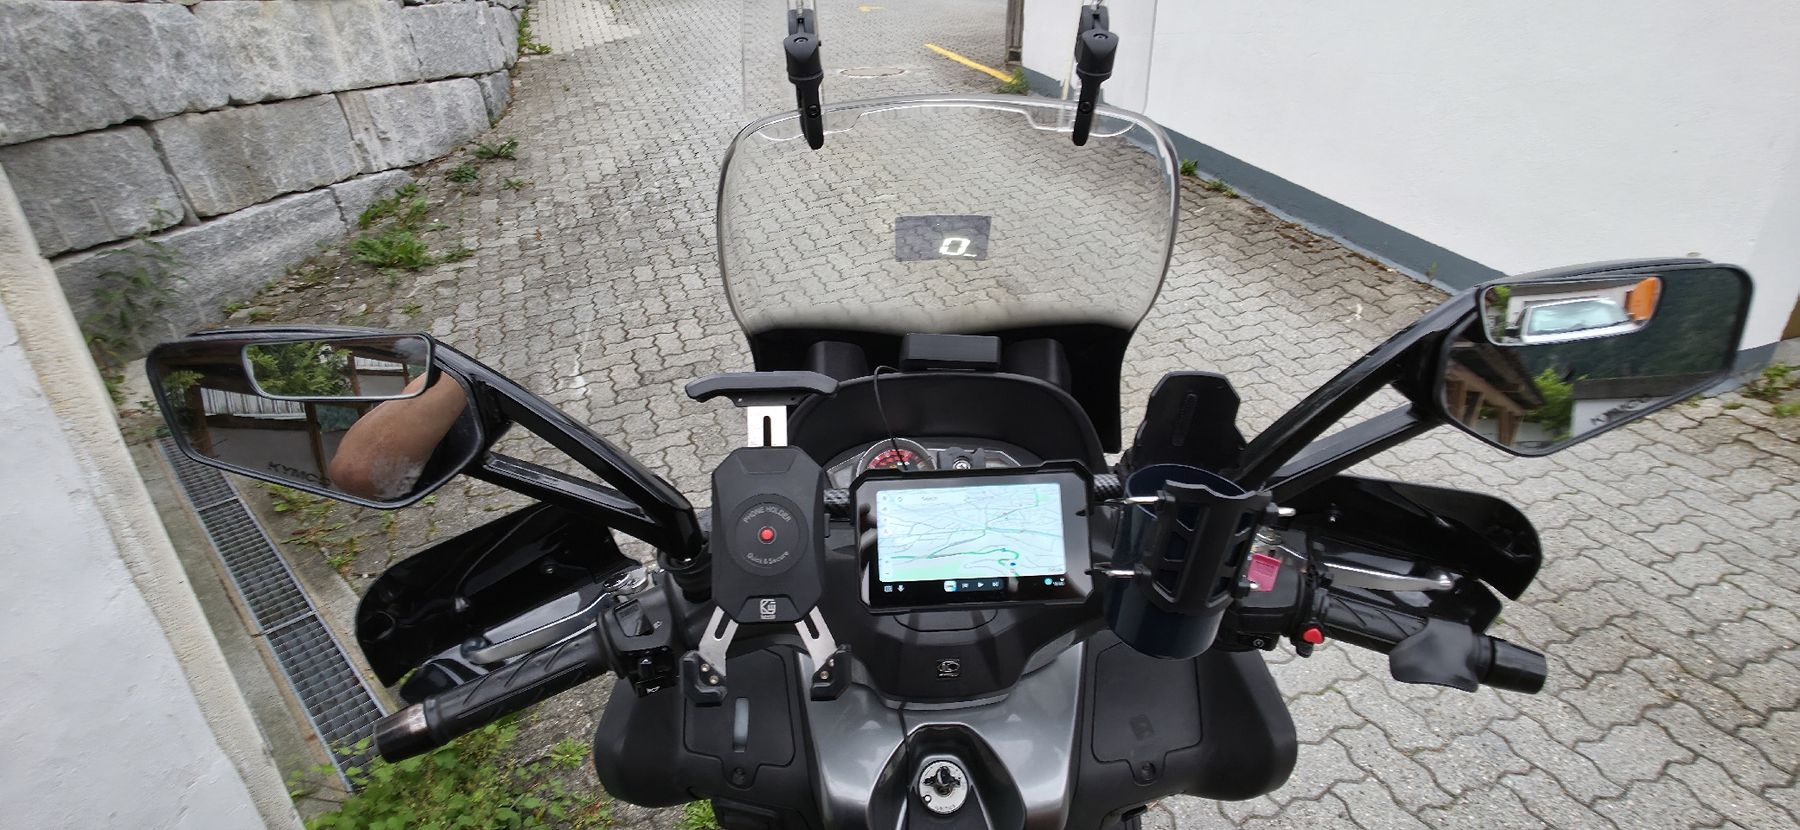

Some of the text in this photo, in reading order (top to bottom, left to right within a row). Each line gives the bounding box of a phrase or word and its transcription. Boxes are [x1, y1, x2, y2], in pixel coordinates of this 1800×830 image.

[938, 237, 971, 256] 0
[743, 506, 792, 523] PHONE HOLDER
[746, 552, 763, 564] Quick
[768, 551, 790, 565] Secure
